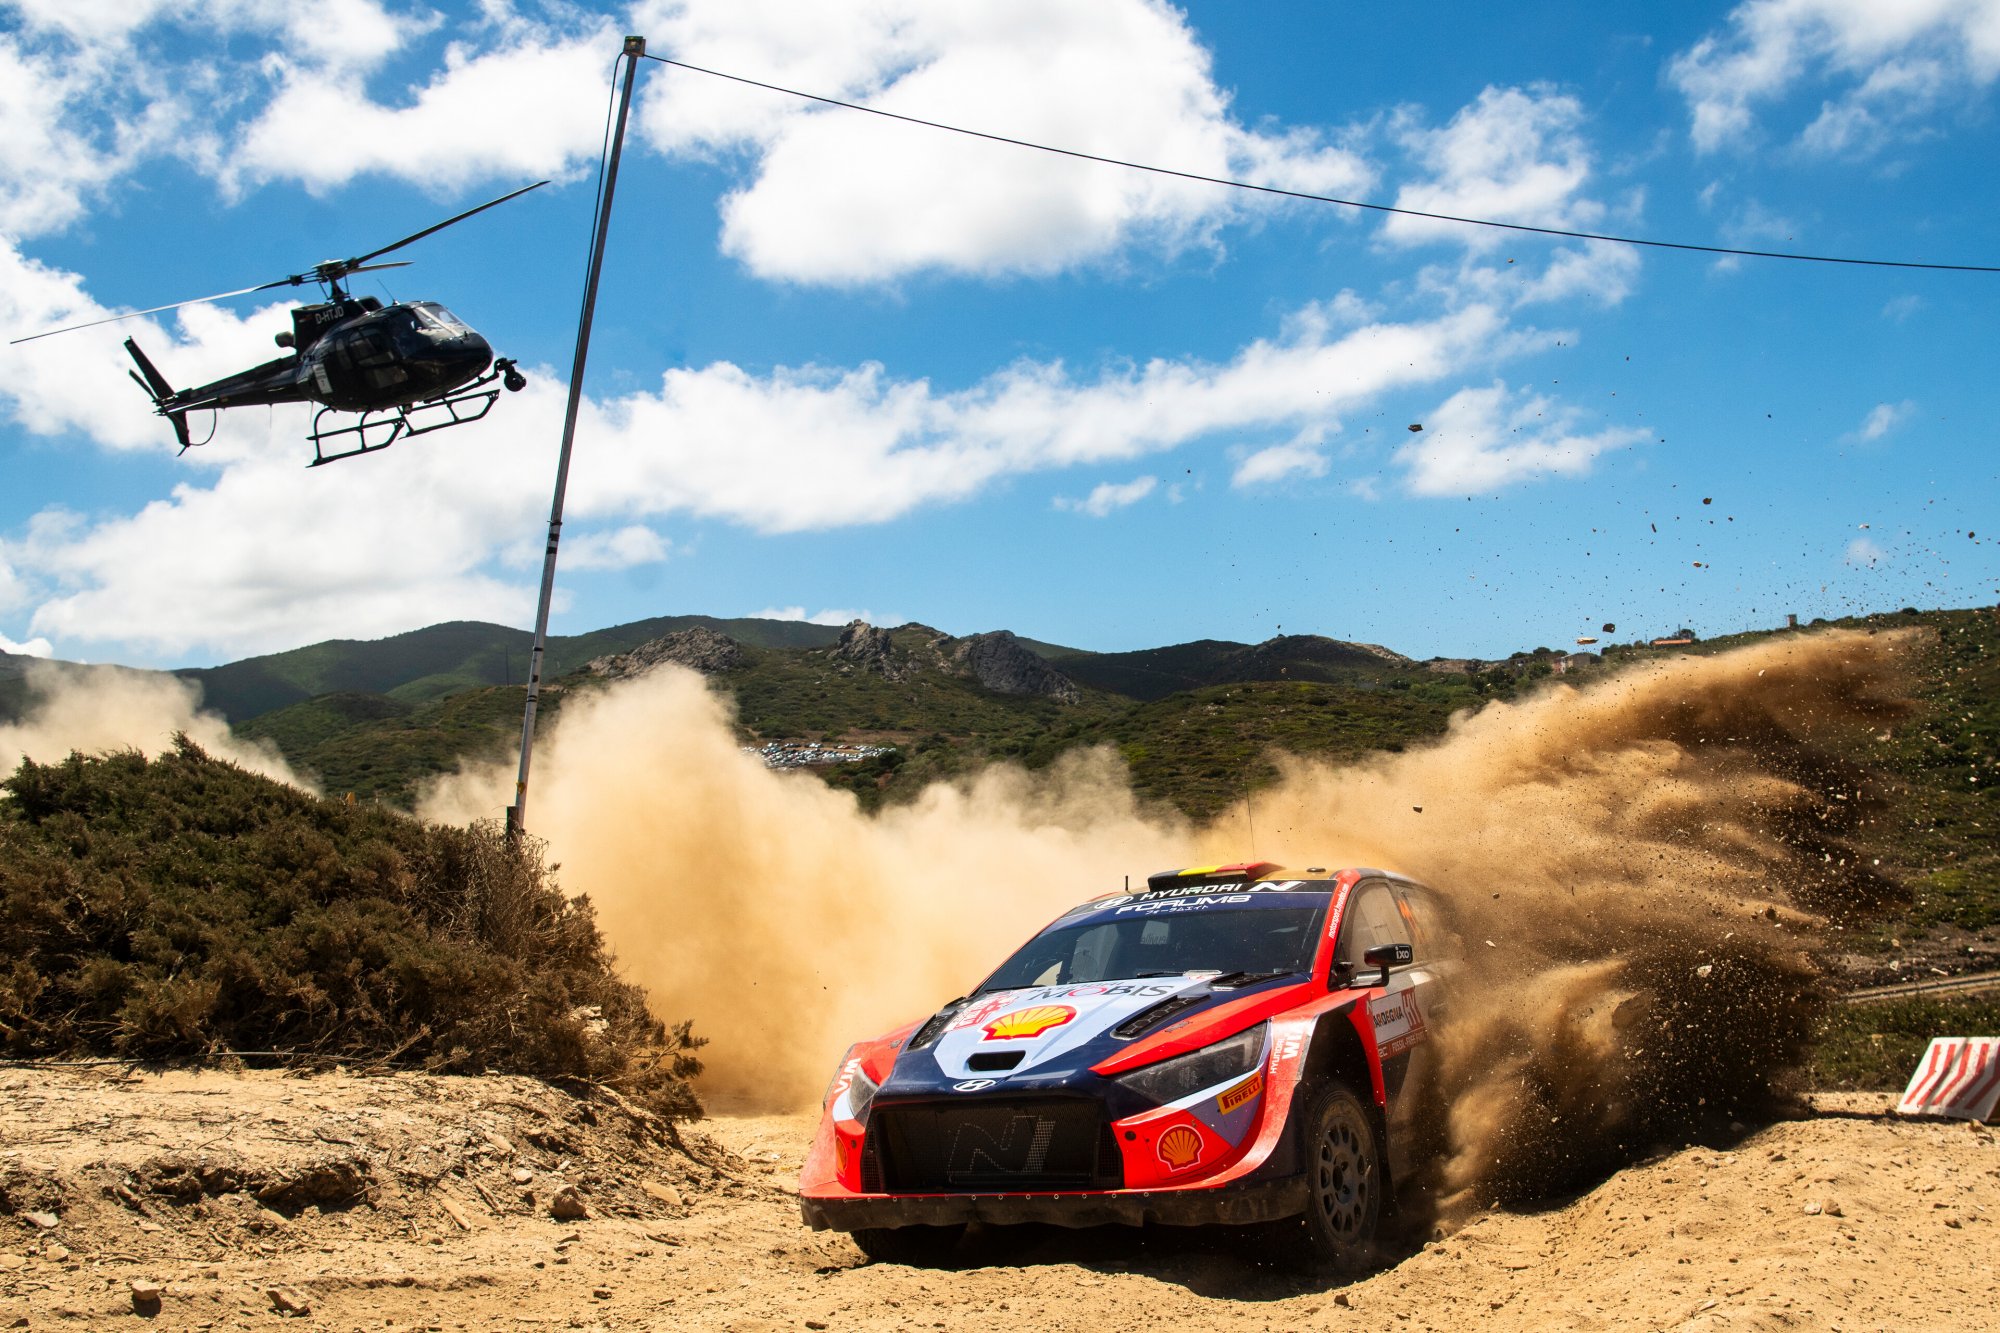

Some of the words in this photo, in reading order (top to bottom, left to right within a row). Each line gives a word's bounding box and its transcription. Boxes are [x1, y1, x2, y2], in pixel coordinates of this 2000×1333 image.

[1115, 895, 1252, 915] FORUM8
[1030, 985, 1175, 999] MOBIS
[1373, 1006, 1404, 1028] ARDEGNA
[1270, 1039, 1284, 1074] HYUNDAI
[1222, 1077, 1260, 1109] PIRELLI
